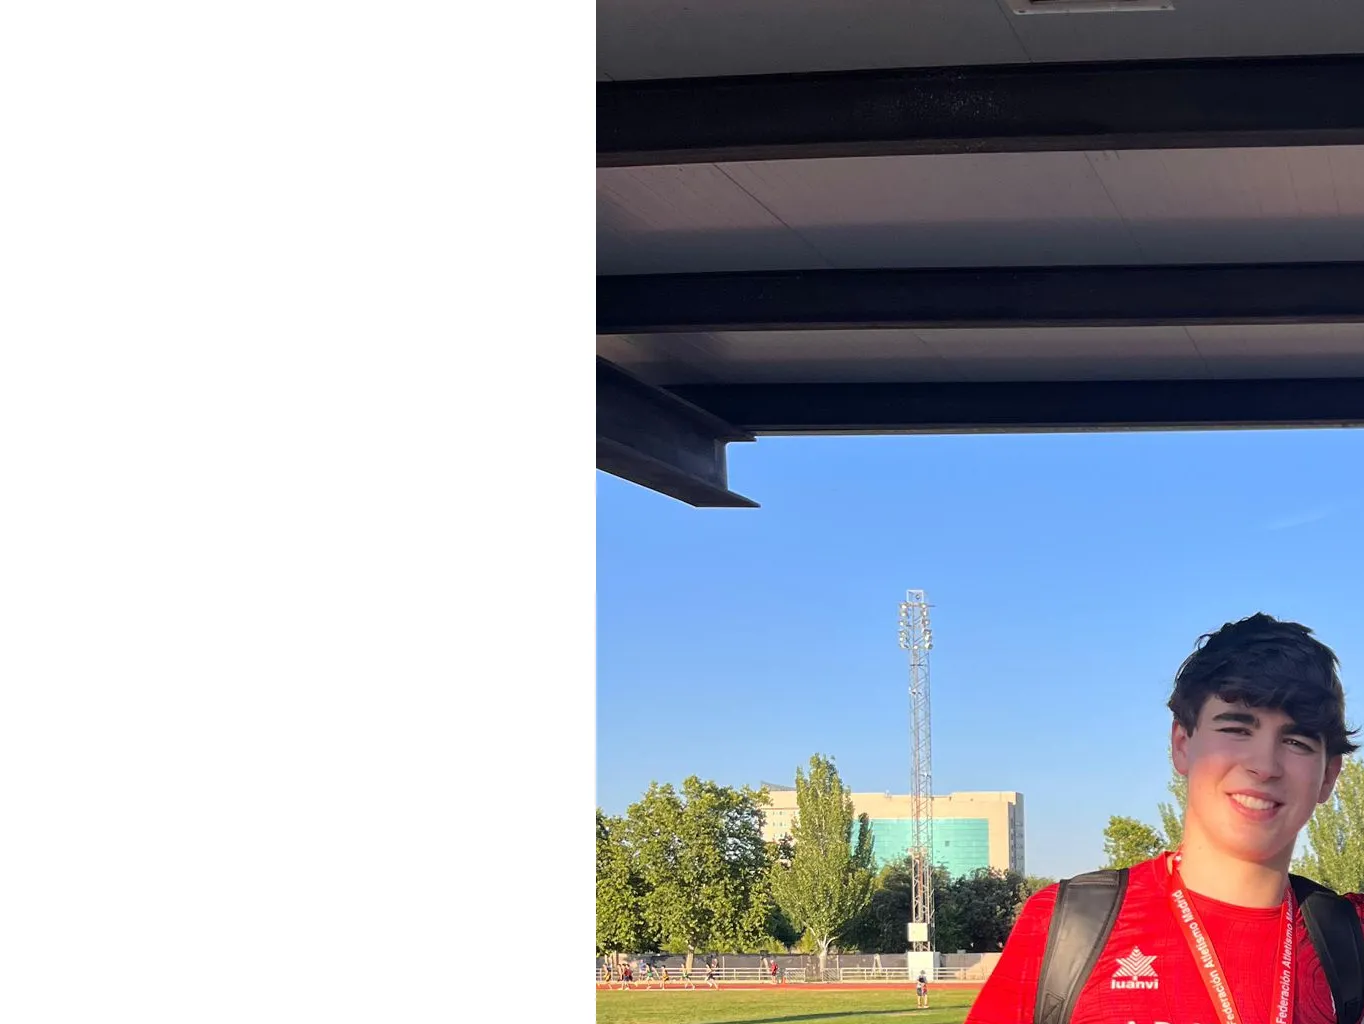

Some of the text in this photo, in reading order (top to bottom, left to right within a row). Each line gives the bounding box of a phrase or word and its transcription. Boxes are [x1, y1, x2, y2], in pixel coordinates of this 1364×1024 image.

[1172, 890, 1195, 923] Madrid
[1189, 922, 1215, 969] Atletismo
[1281, 923, 1293, 969] Atletismo
[1111, 979, 1159, 990] luanvi
[1275, 969, 1292, 1024] Federación
